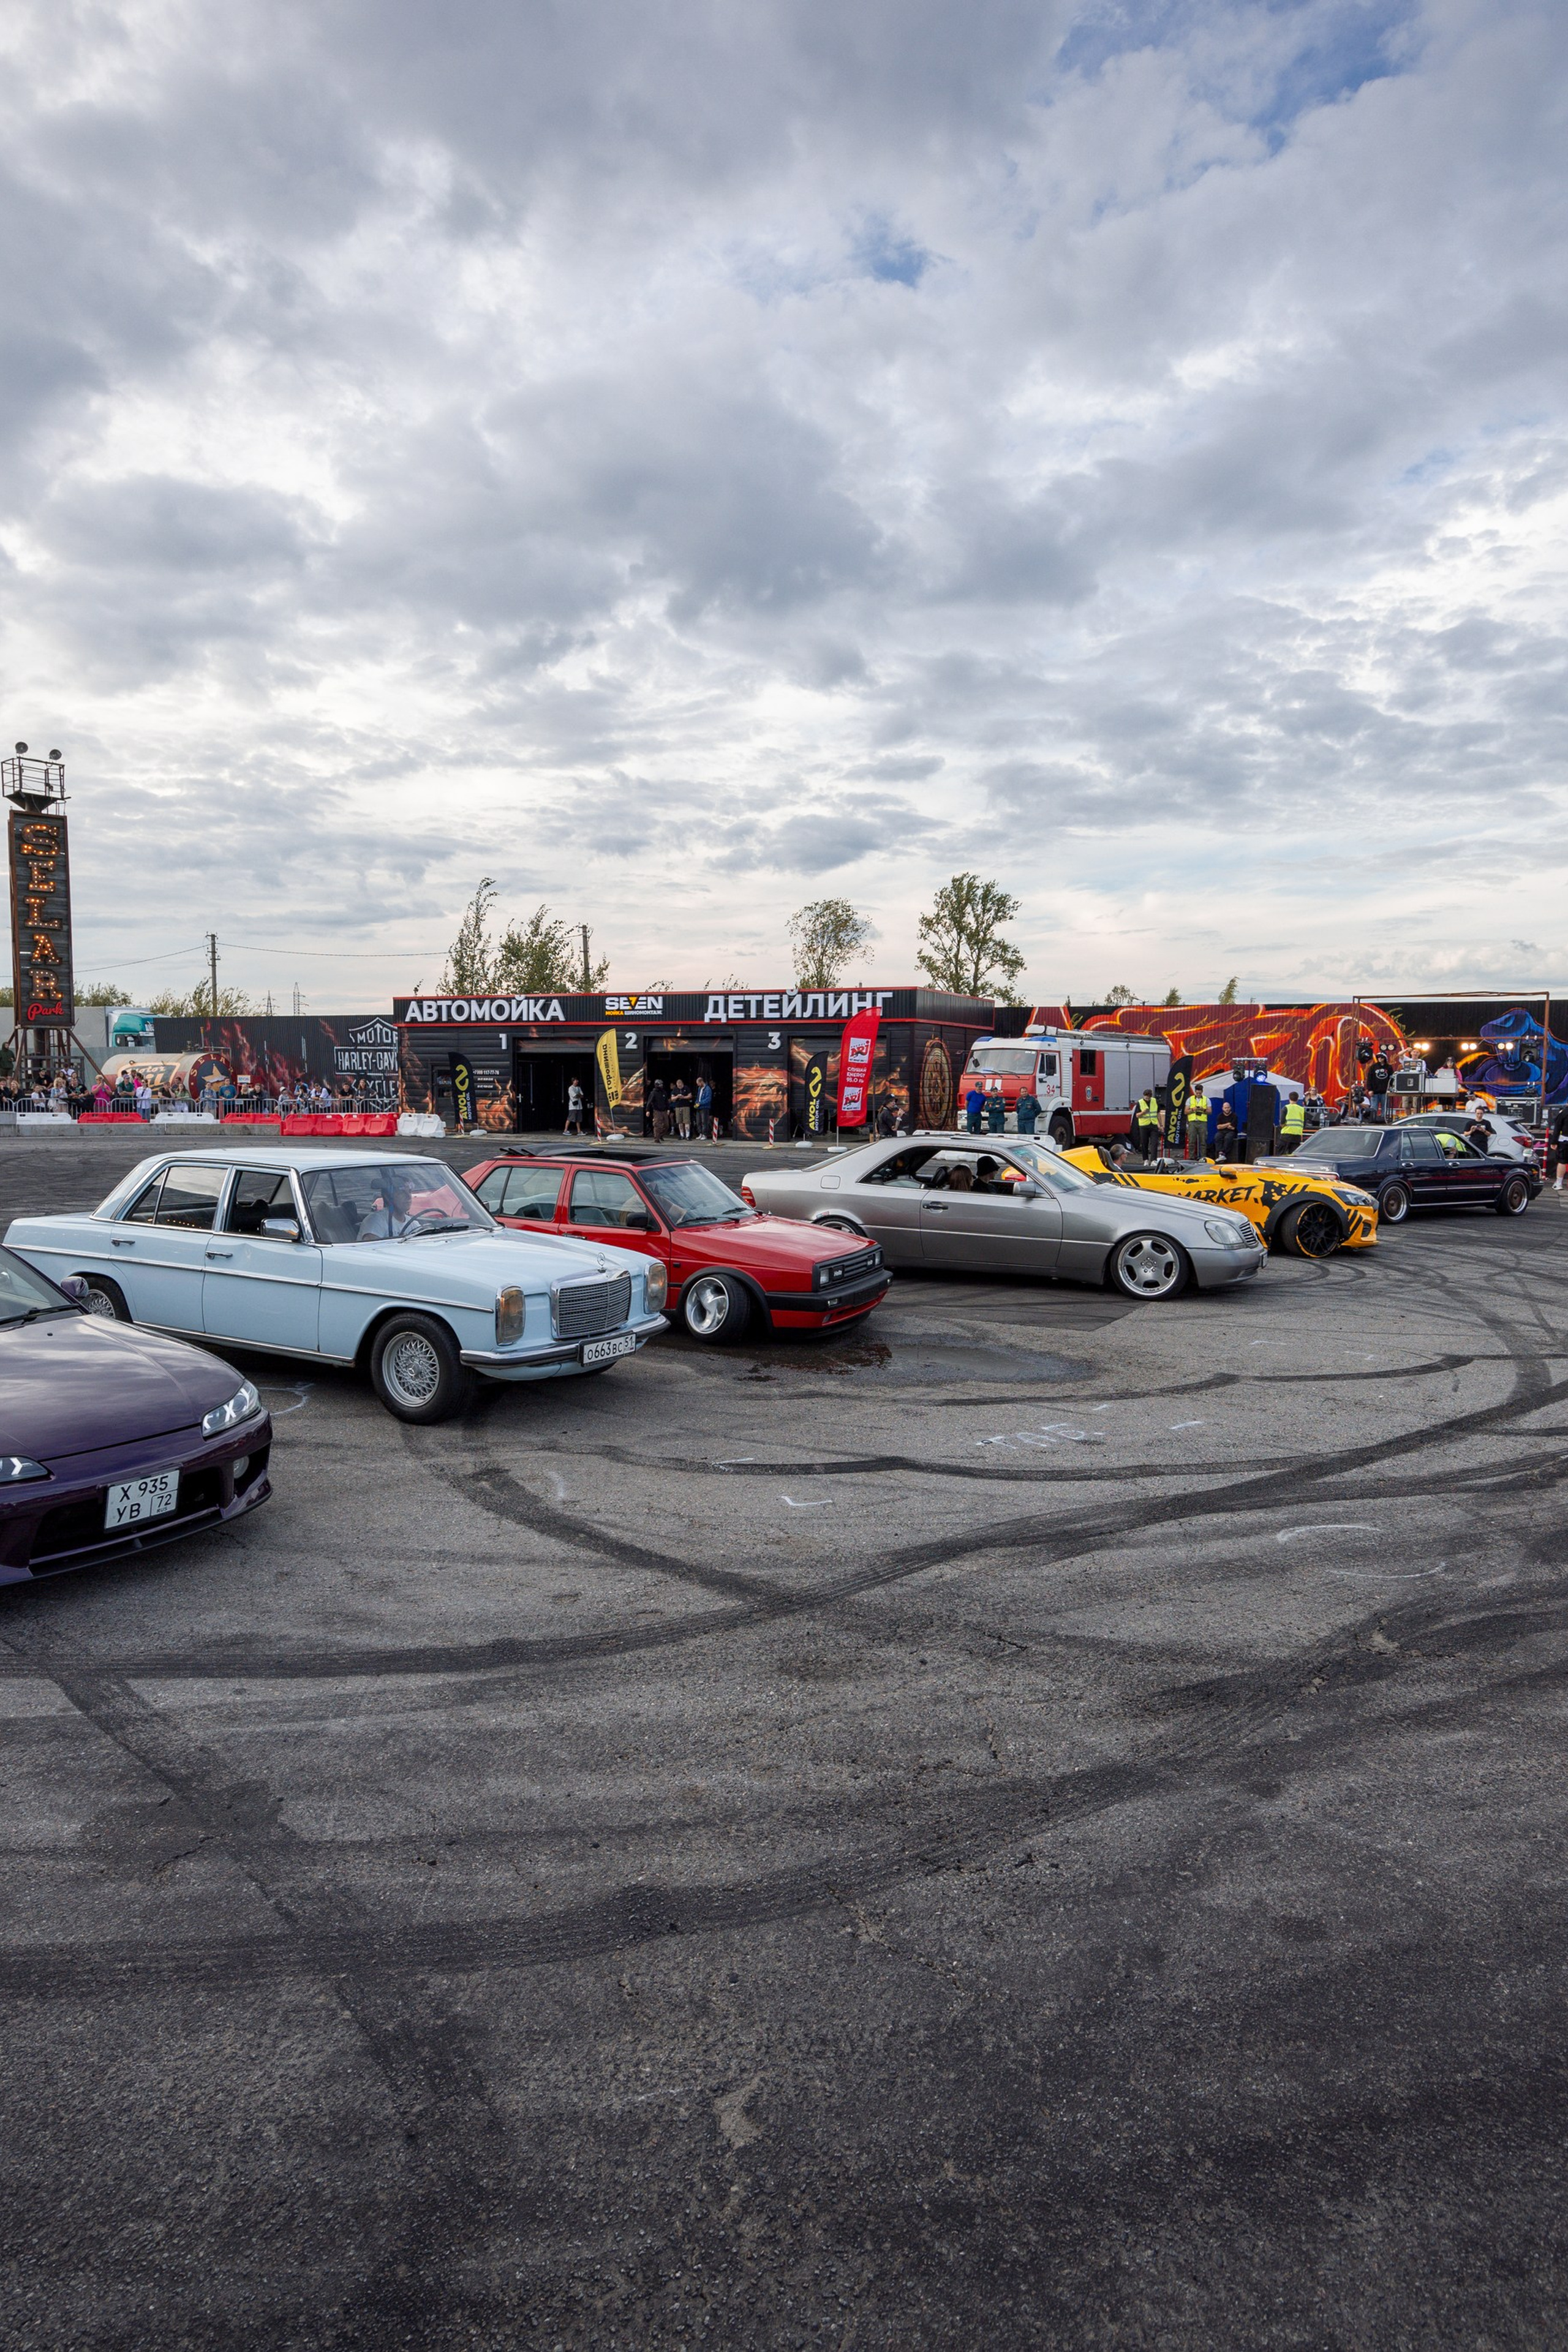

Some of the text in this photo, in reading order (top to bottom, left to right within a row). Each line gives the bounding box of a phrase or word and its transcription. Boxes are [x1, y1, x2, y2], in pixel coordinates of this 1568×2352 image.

[20, 823, 63, 1000] SELAR
[28, 1001, 64, 1020] Park
[405, 994, 565, 1022] АВТОМОЙКА
[704, 989, 893, 1023] ДЕТЕЙЛИНГ
[499, 1033, 508, 1050] 1
[625, 1032, 638, 1049] 2
[767, 1032, 782, 1050] 3
[1046, 1084, 1055, 1095] 34
[458, 1092, 469, 1120] AVOL
[1167, 1108, 1178, 1144] AVOL
[625, 1336, 633, 1348] 51
[119, 1476, 168, 1502] Х 935
[117, 1494, 172, 1523] УВ 72
